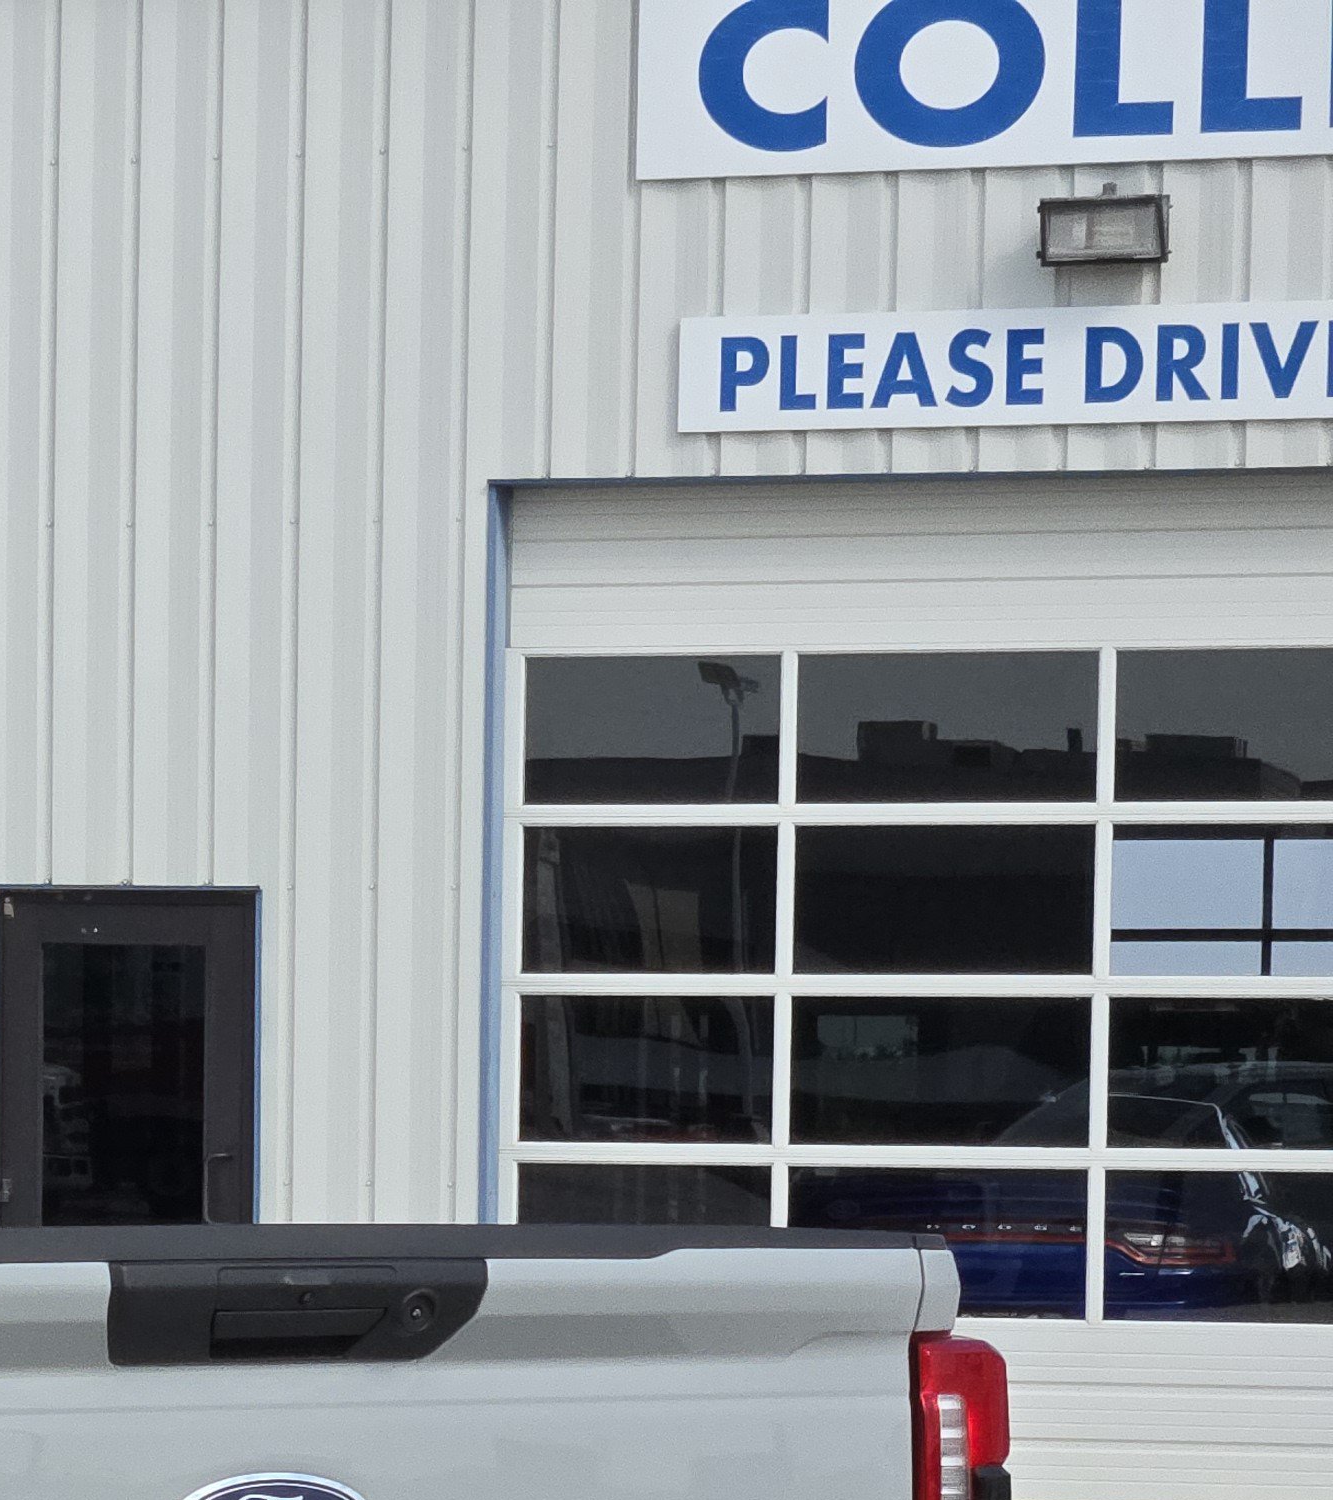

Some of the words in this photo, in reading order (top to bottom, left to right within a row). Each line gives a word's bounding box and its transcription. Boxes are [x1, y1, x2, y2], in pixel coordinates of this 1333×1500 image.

[698, 0, 1333, 152] COLL
[719, 328, 1045, 412] PLEASE
[1084, 320, 1333, 403] DRIV
